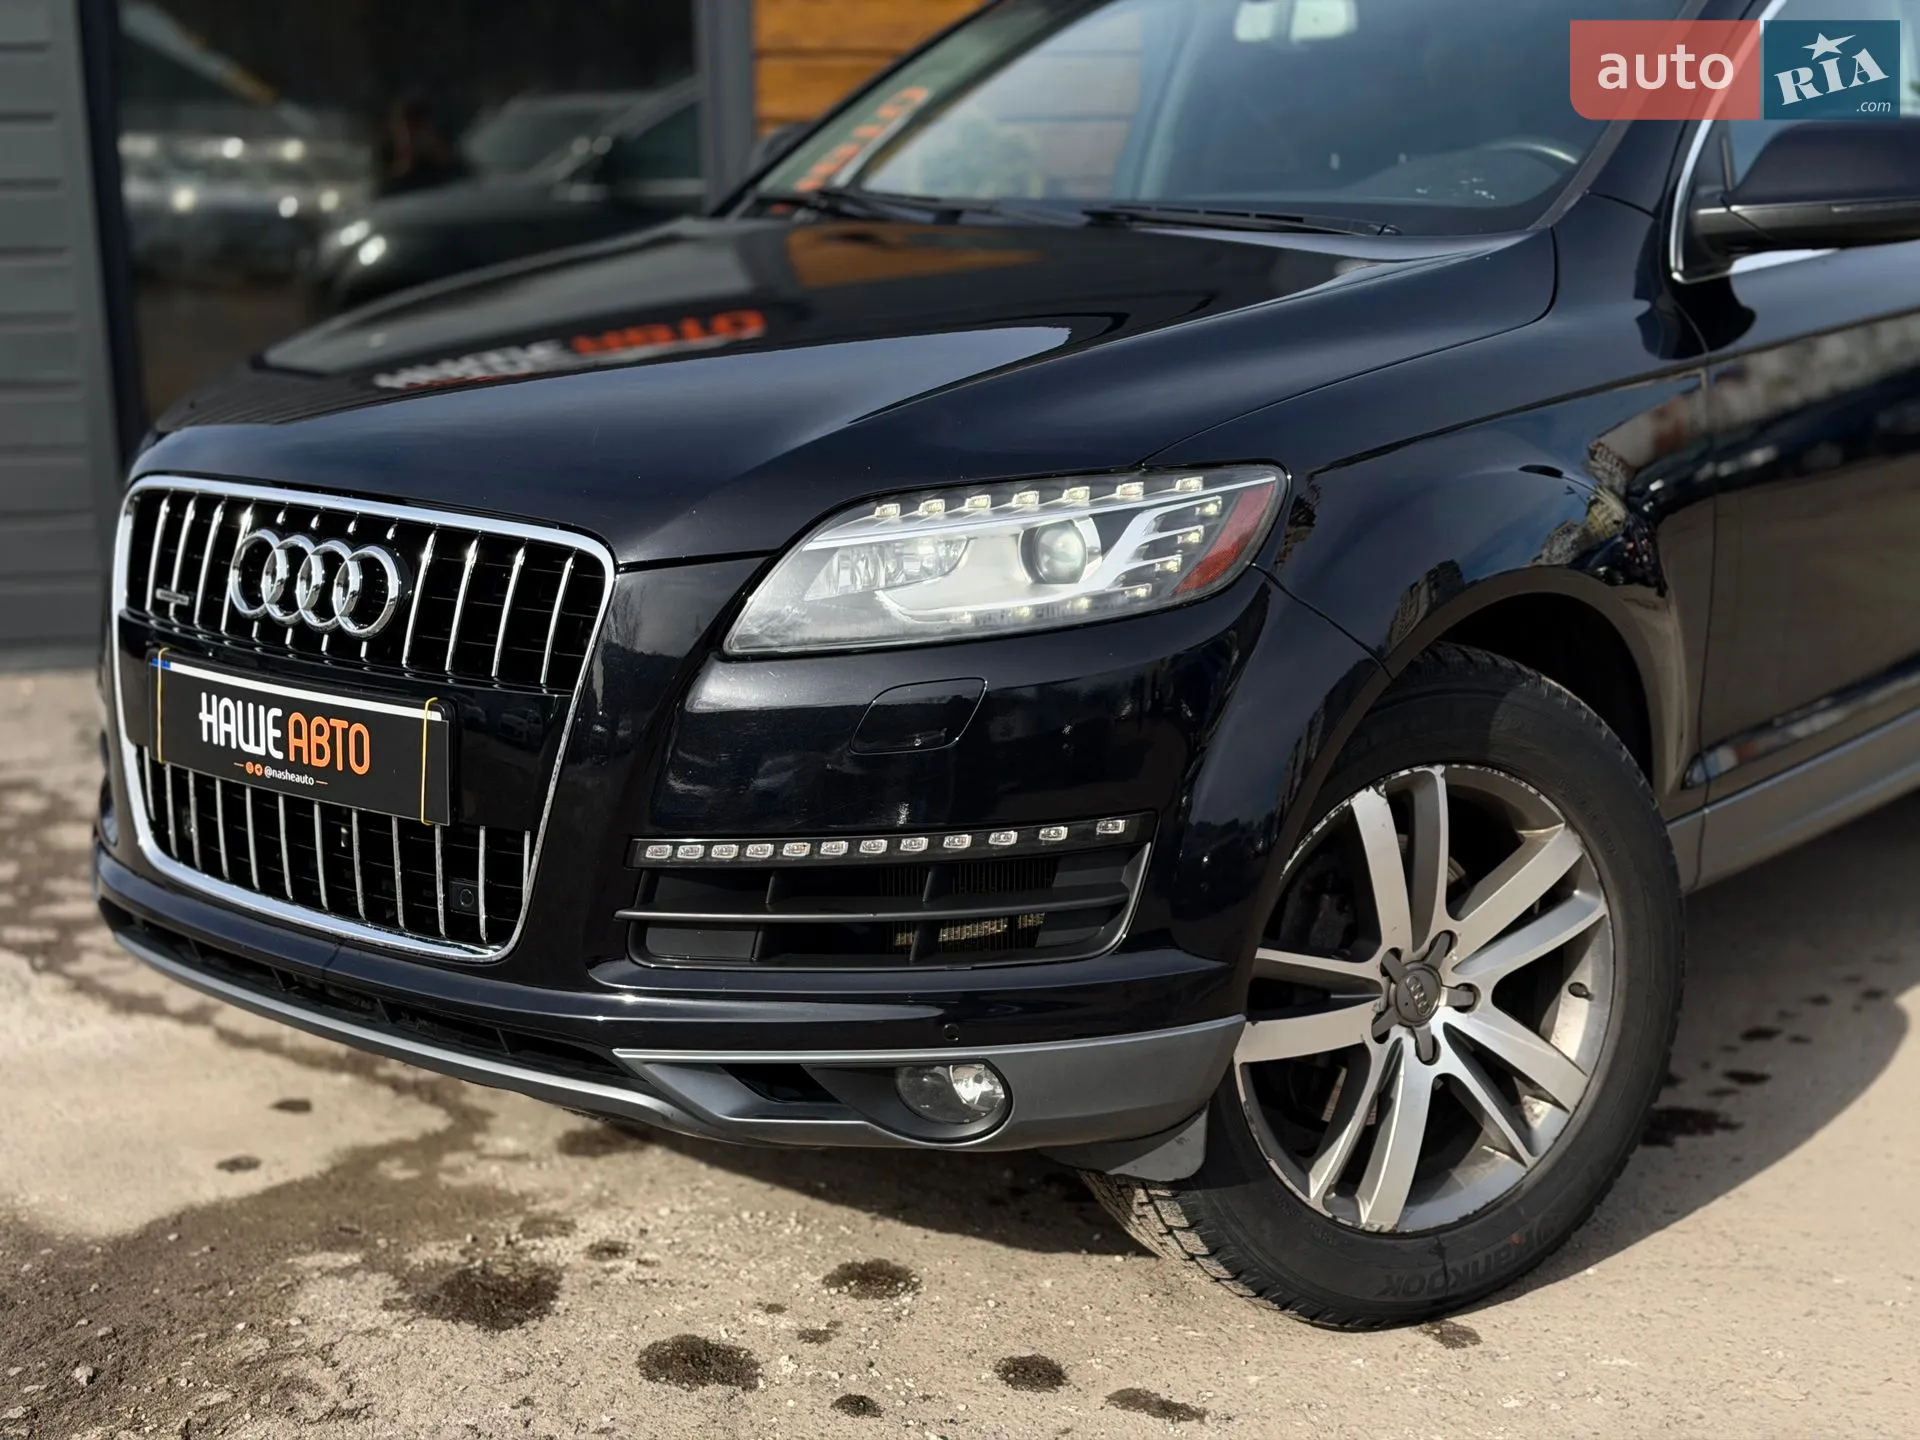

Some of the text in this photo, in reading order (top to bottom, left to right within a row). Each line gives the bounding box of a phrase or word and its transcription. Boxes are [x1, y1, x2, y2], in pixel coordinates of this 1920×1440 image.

[198, 691, 370, 776] НАШЕ АВТО
[264, 764, 315, 787] @nasheauto
